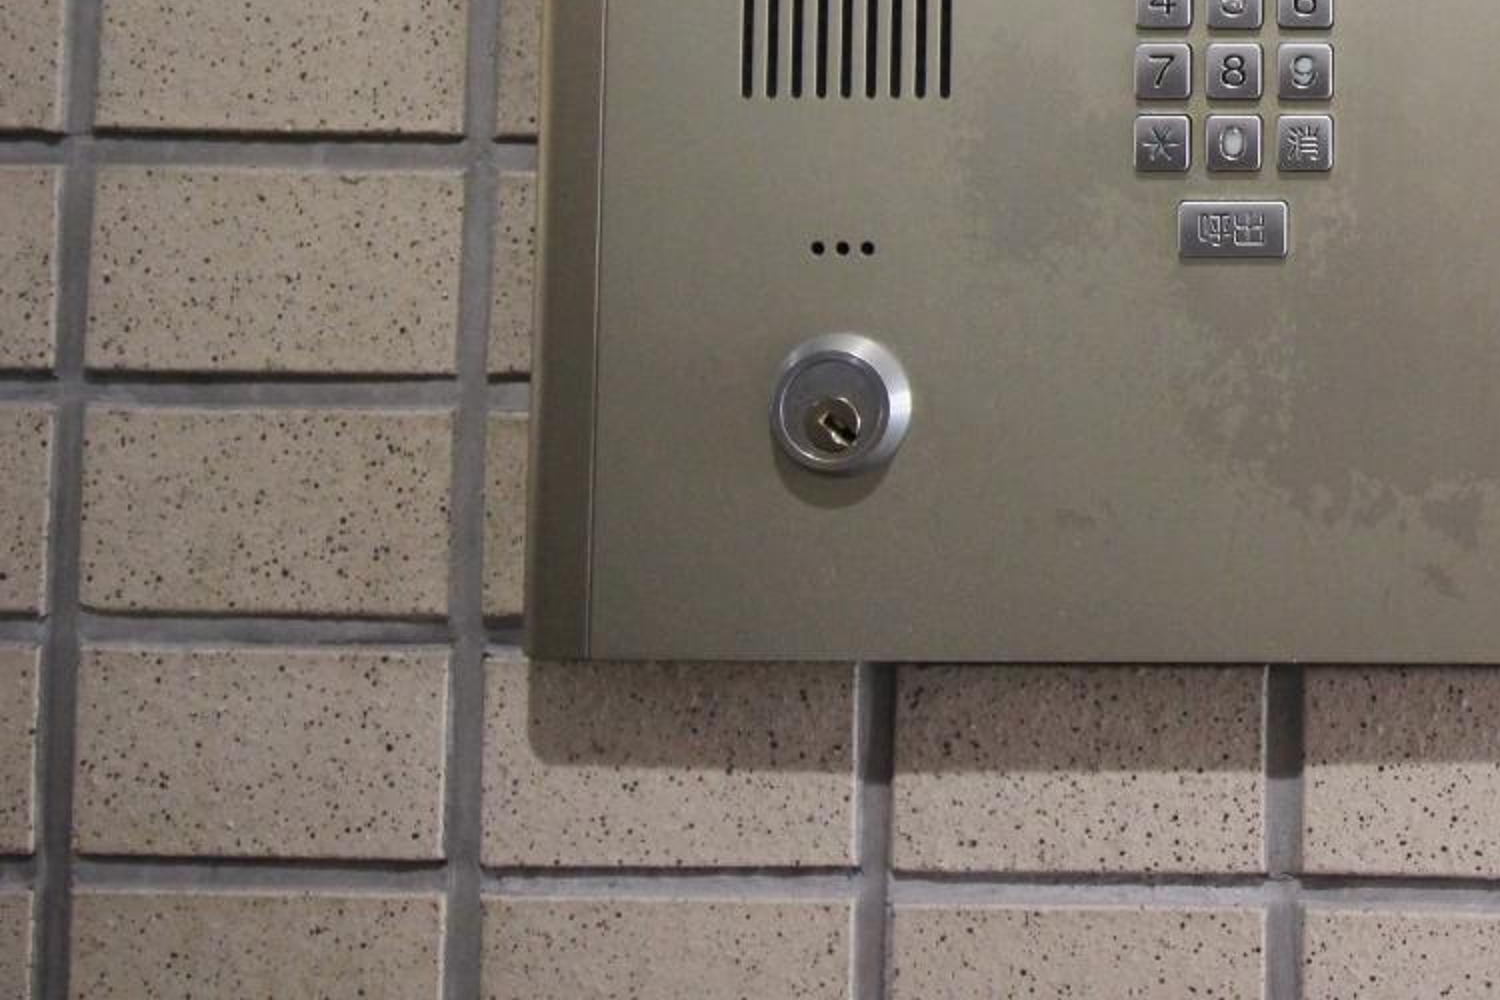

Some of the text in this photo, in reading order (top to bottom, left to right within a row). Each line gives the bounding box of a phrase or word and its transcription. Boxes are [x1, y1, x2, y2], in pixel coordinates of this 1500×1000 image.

[1148, 54, 1175, 88] 7
[1220, 54, 1247, 88] 8
[1290, 54, 1317, 89] 9
[1218, 125, 1247, 161] 0
[1197, 213, 1265, 247] 呼出
